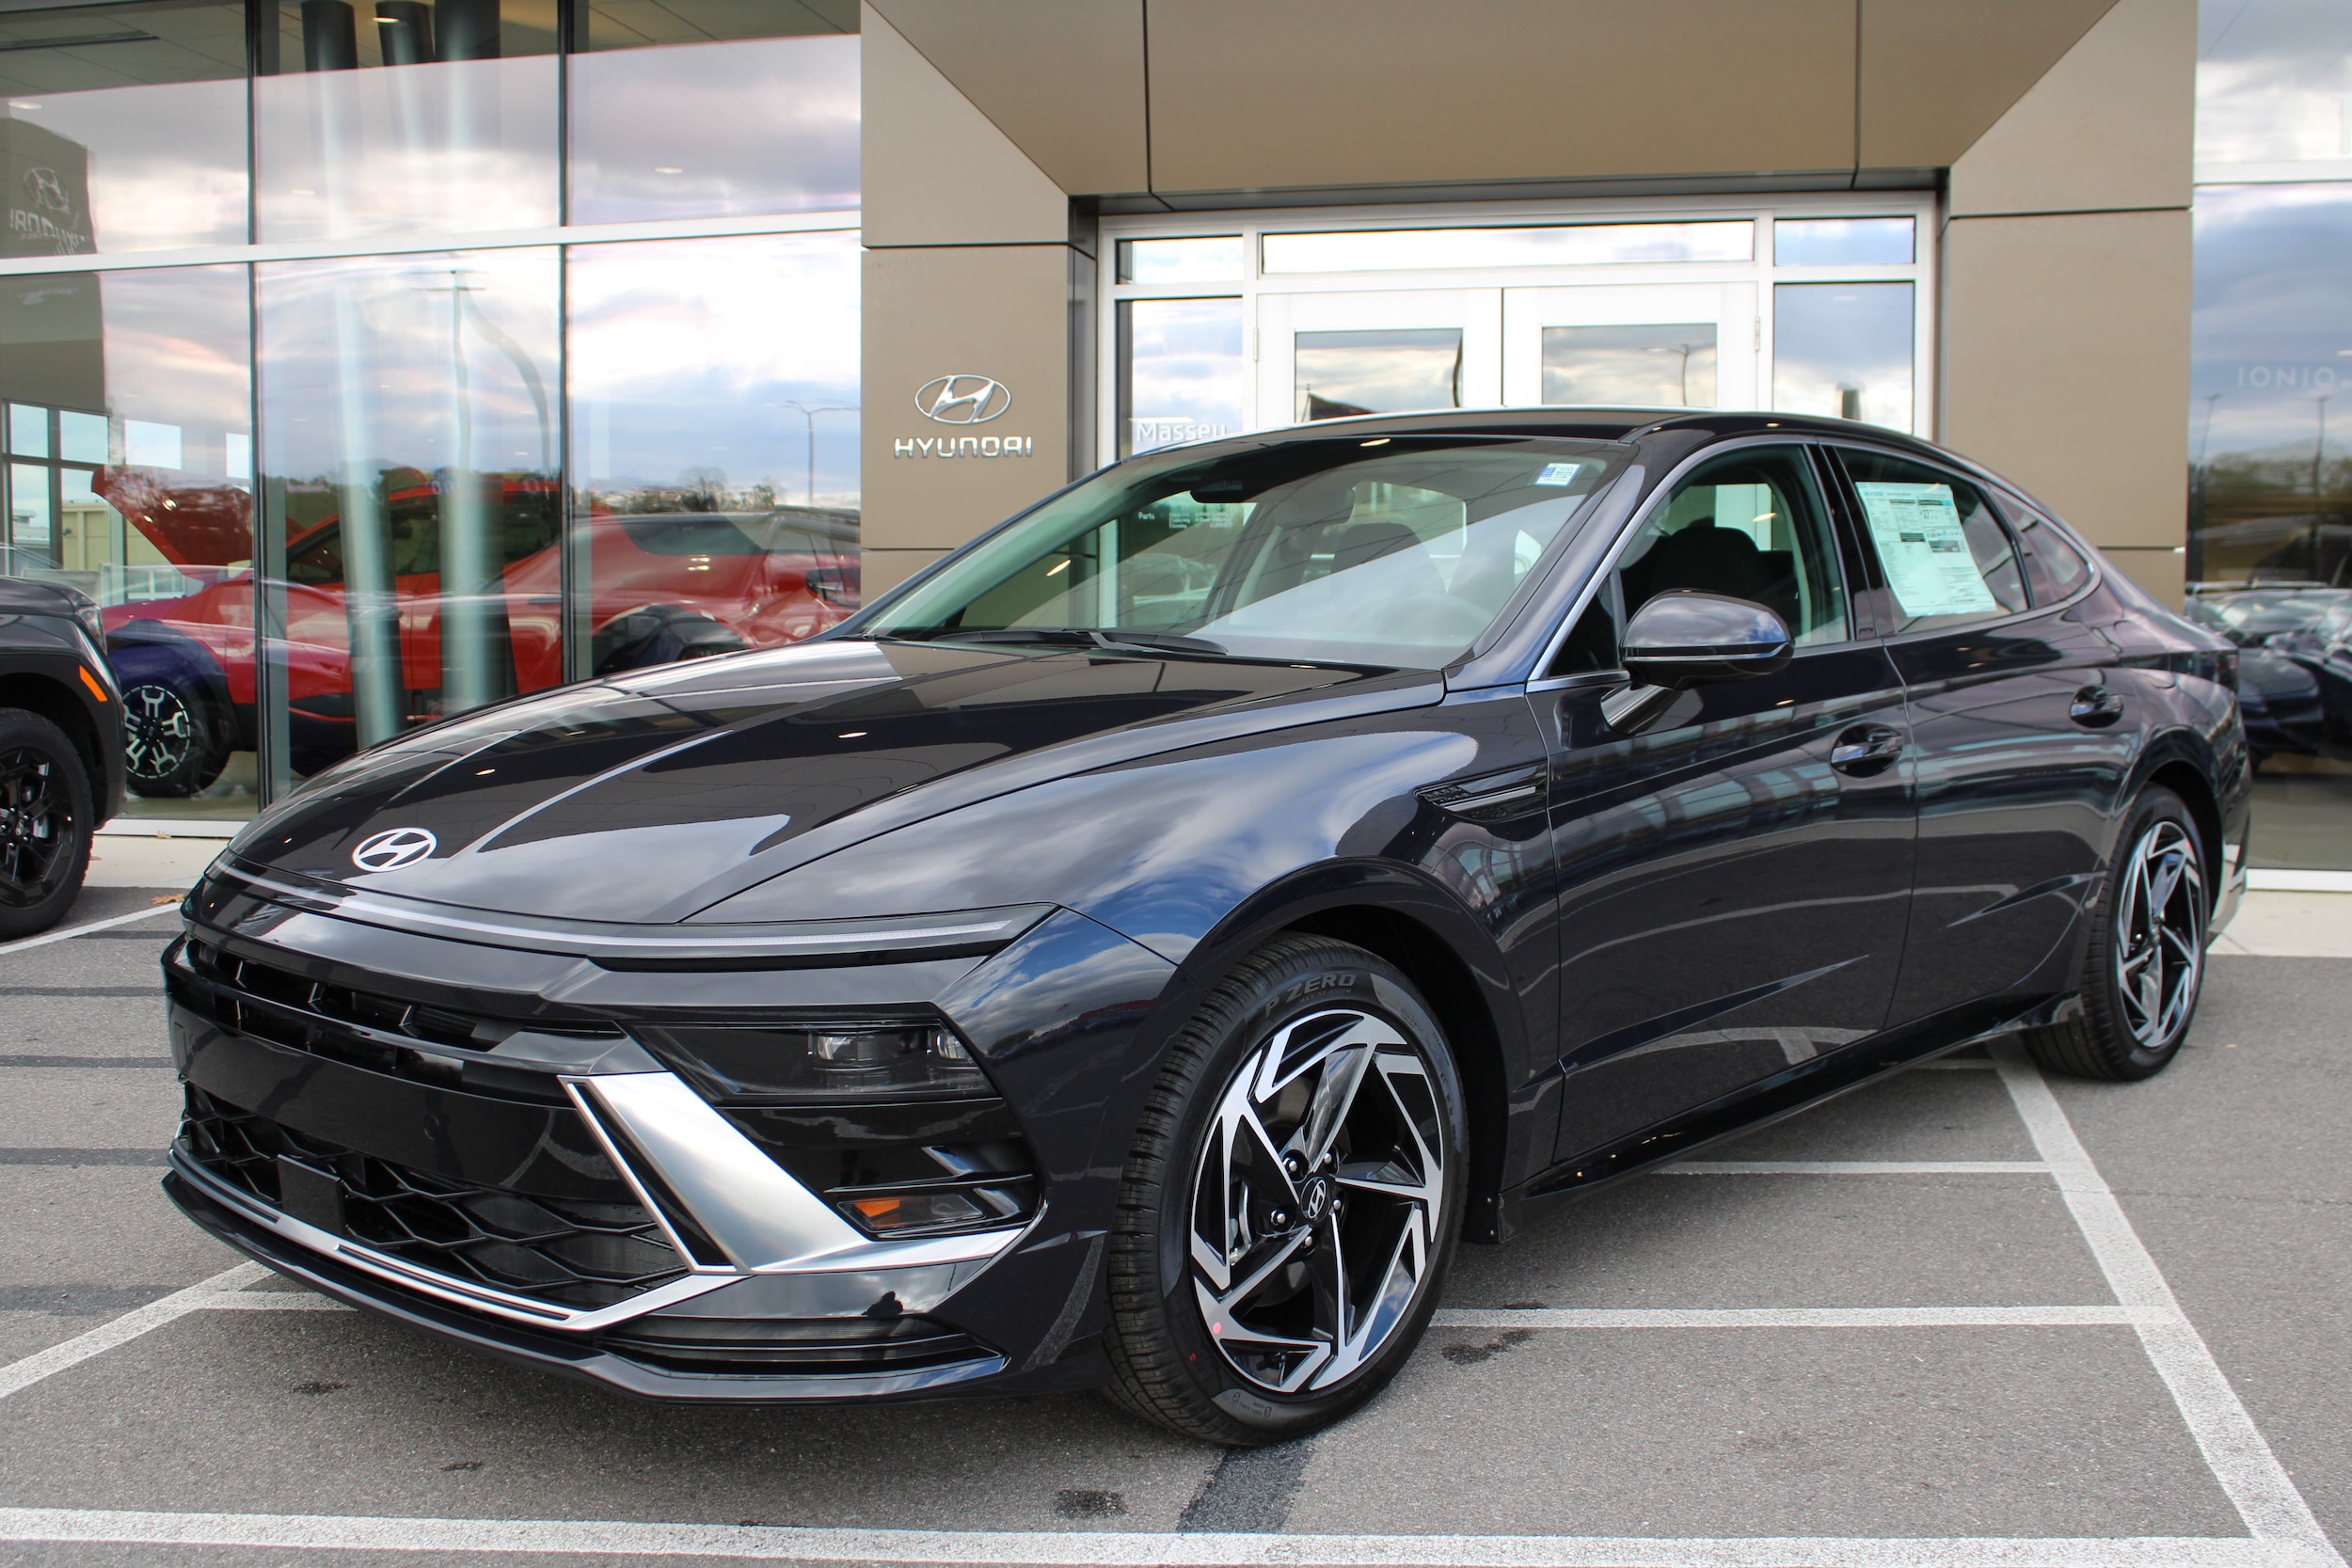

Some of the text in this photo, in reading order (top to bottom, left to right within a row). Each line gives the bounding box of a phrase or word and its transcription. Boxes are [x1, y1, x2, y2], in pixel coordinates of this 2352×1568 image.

[895, 436, 1032, 458] HYUNDAI
[1137, 512, 1155, 520] Parts
[1264, 974, 1357, 1018] P ZERO
